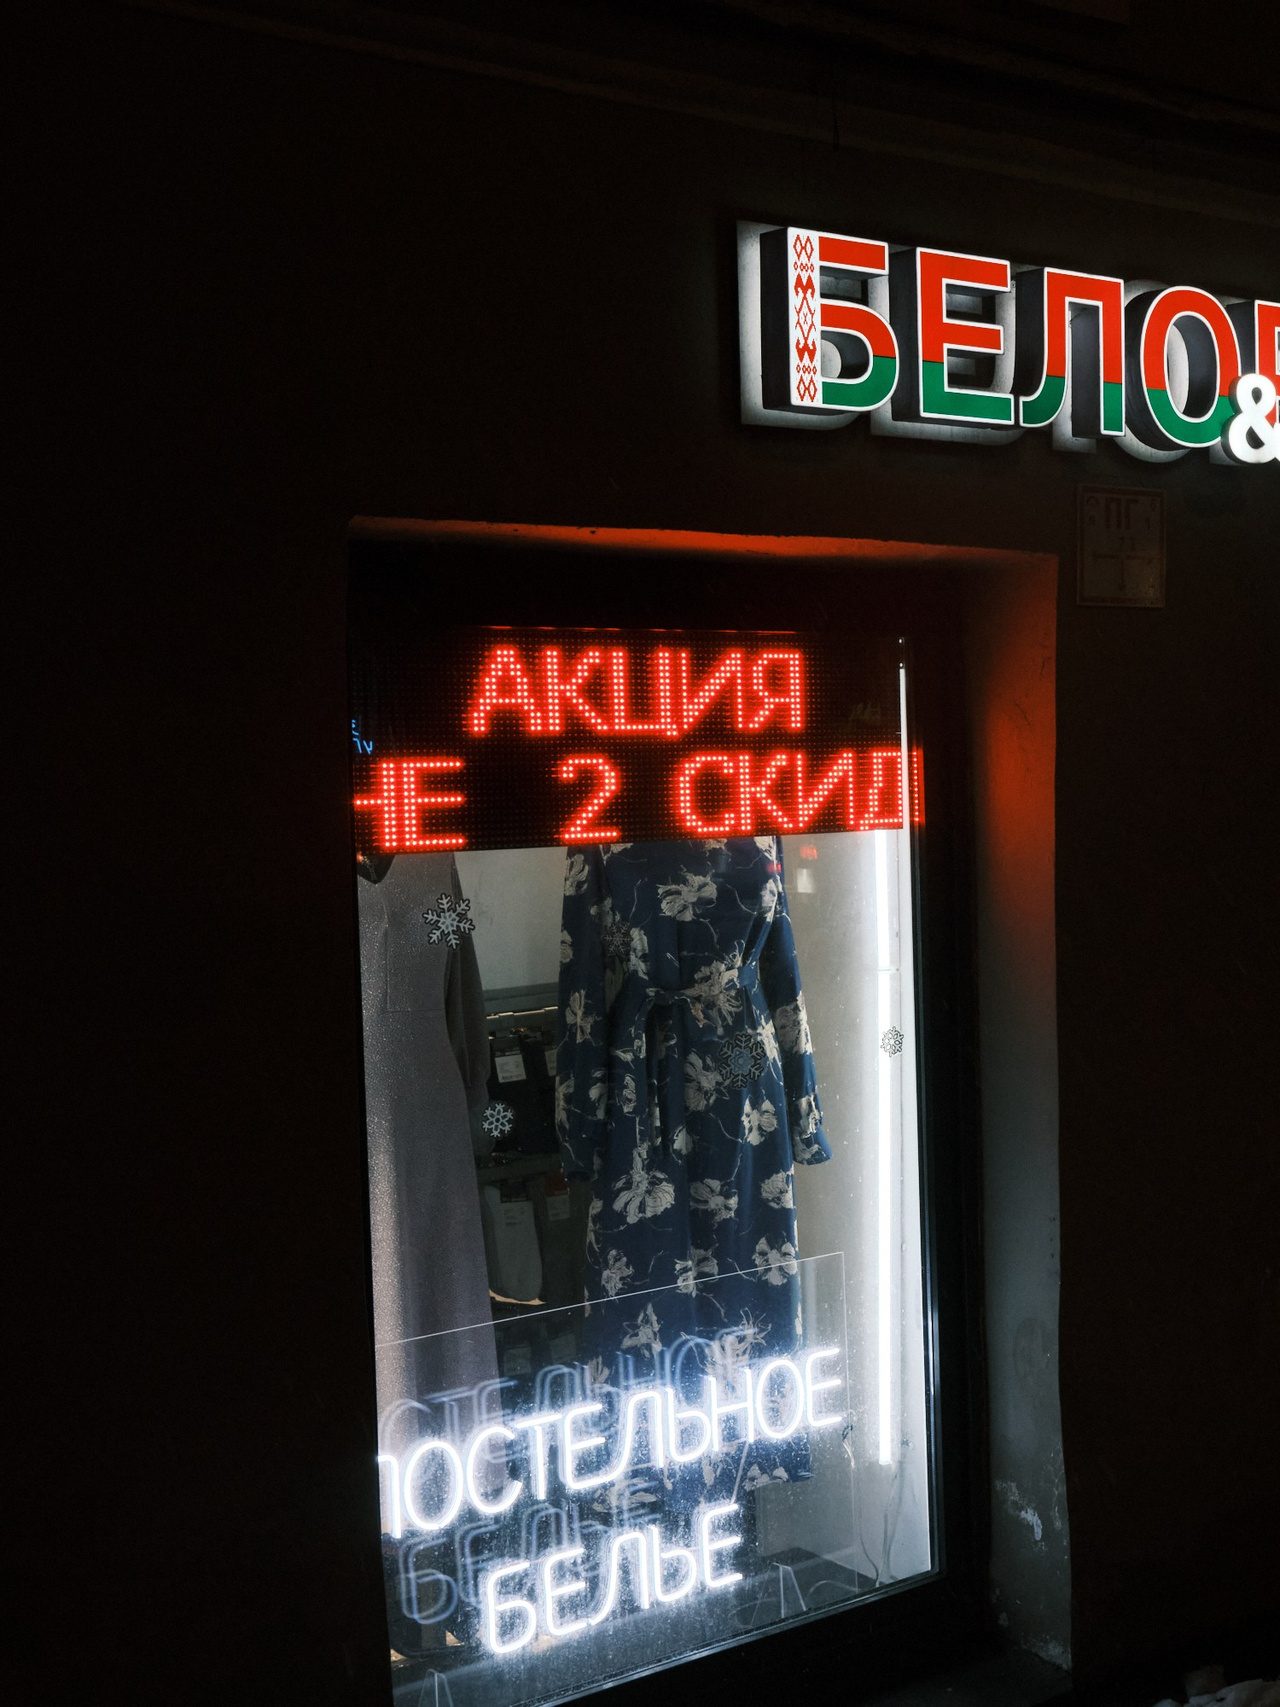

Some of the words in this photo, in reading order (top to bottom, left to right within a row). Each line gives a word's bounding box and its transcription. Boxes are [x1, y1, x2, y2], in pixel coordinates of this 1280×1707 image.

[467, 648, 803, 739] АКЦИЯ
[559, 754, 619, 840] 2
[486, 1502, 744, 1655] БЕЛЬЕ
